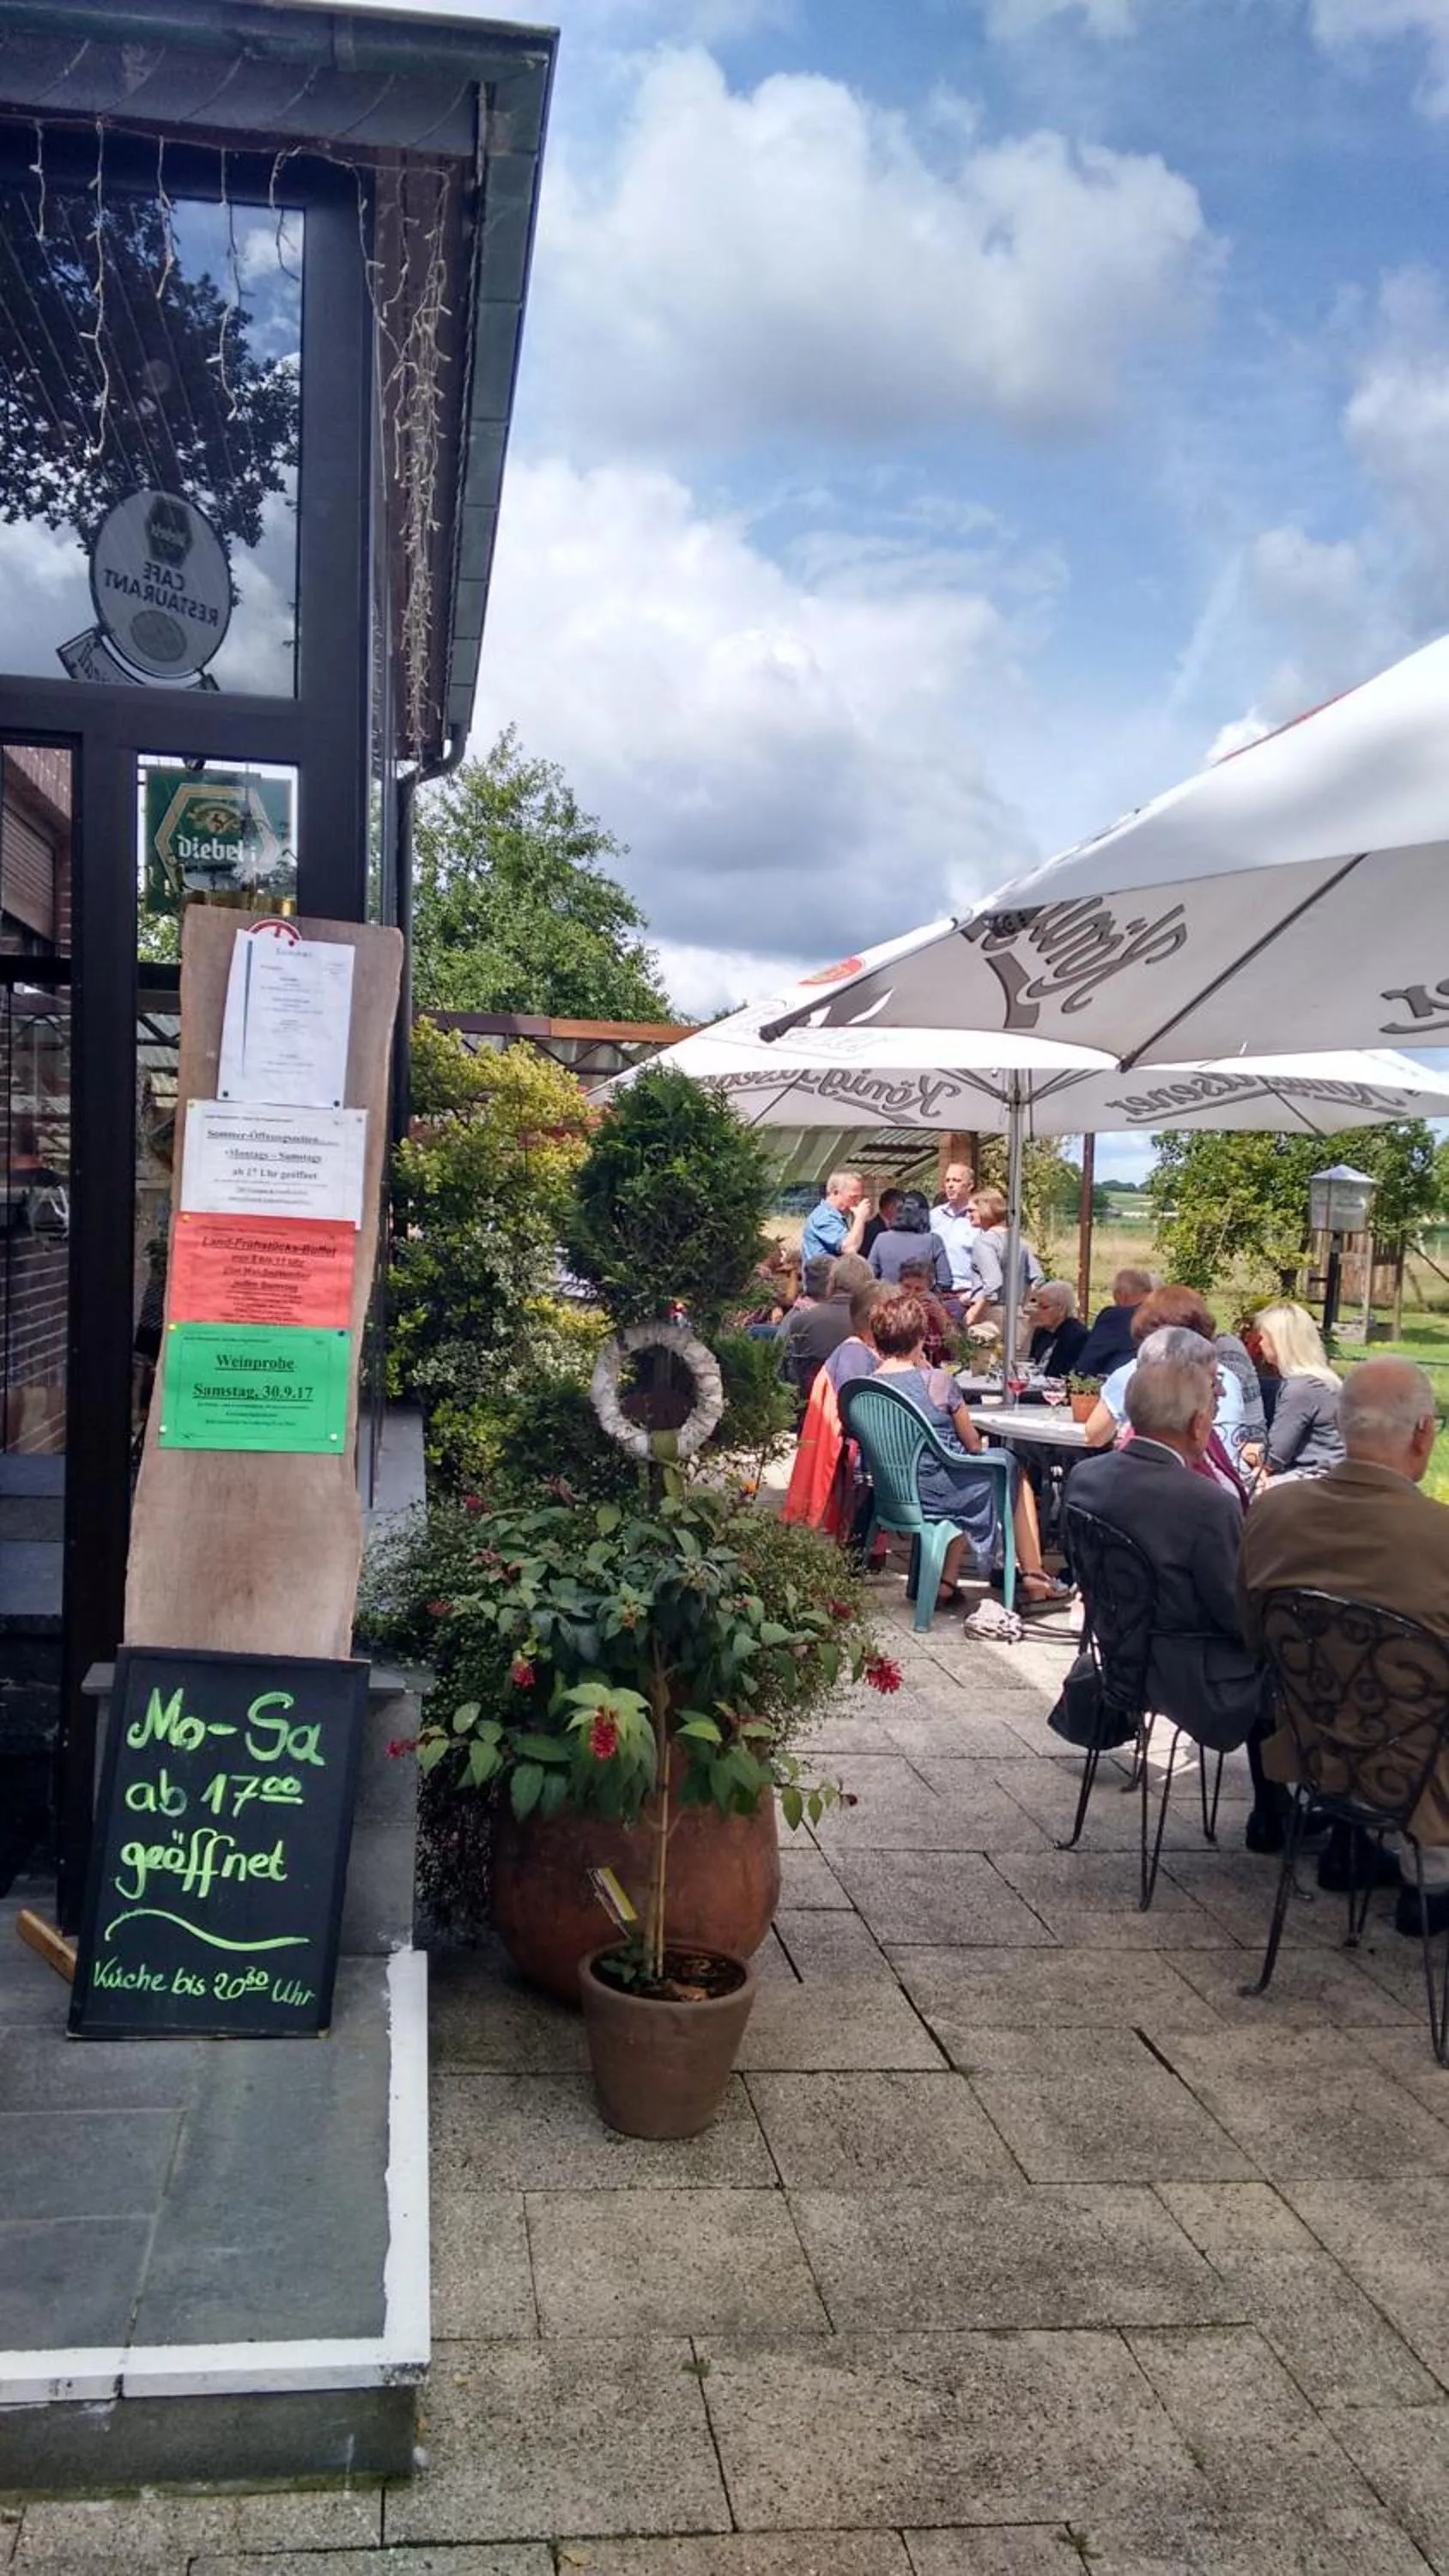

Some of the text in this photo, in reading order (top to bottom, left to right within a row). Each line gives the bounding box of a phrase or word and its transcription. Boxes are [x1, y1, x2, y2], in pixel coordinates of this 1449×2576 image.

[216, 1354, 295, 1371] Weinprobe
[263, 1385, 313, 1400] 30.9.17
[125, 1769, 187, 1817] ab
[114, 1826, 288, 1899] geöffnet
[93, 1955, 167, 1992] Küche
[172, 1966, 206, 1997] bis
[271, 1977, 316, 2007] Uhr
